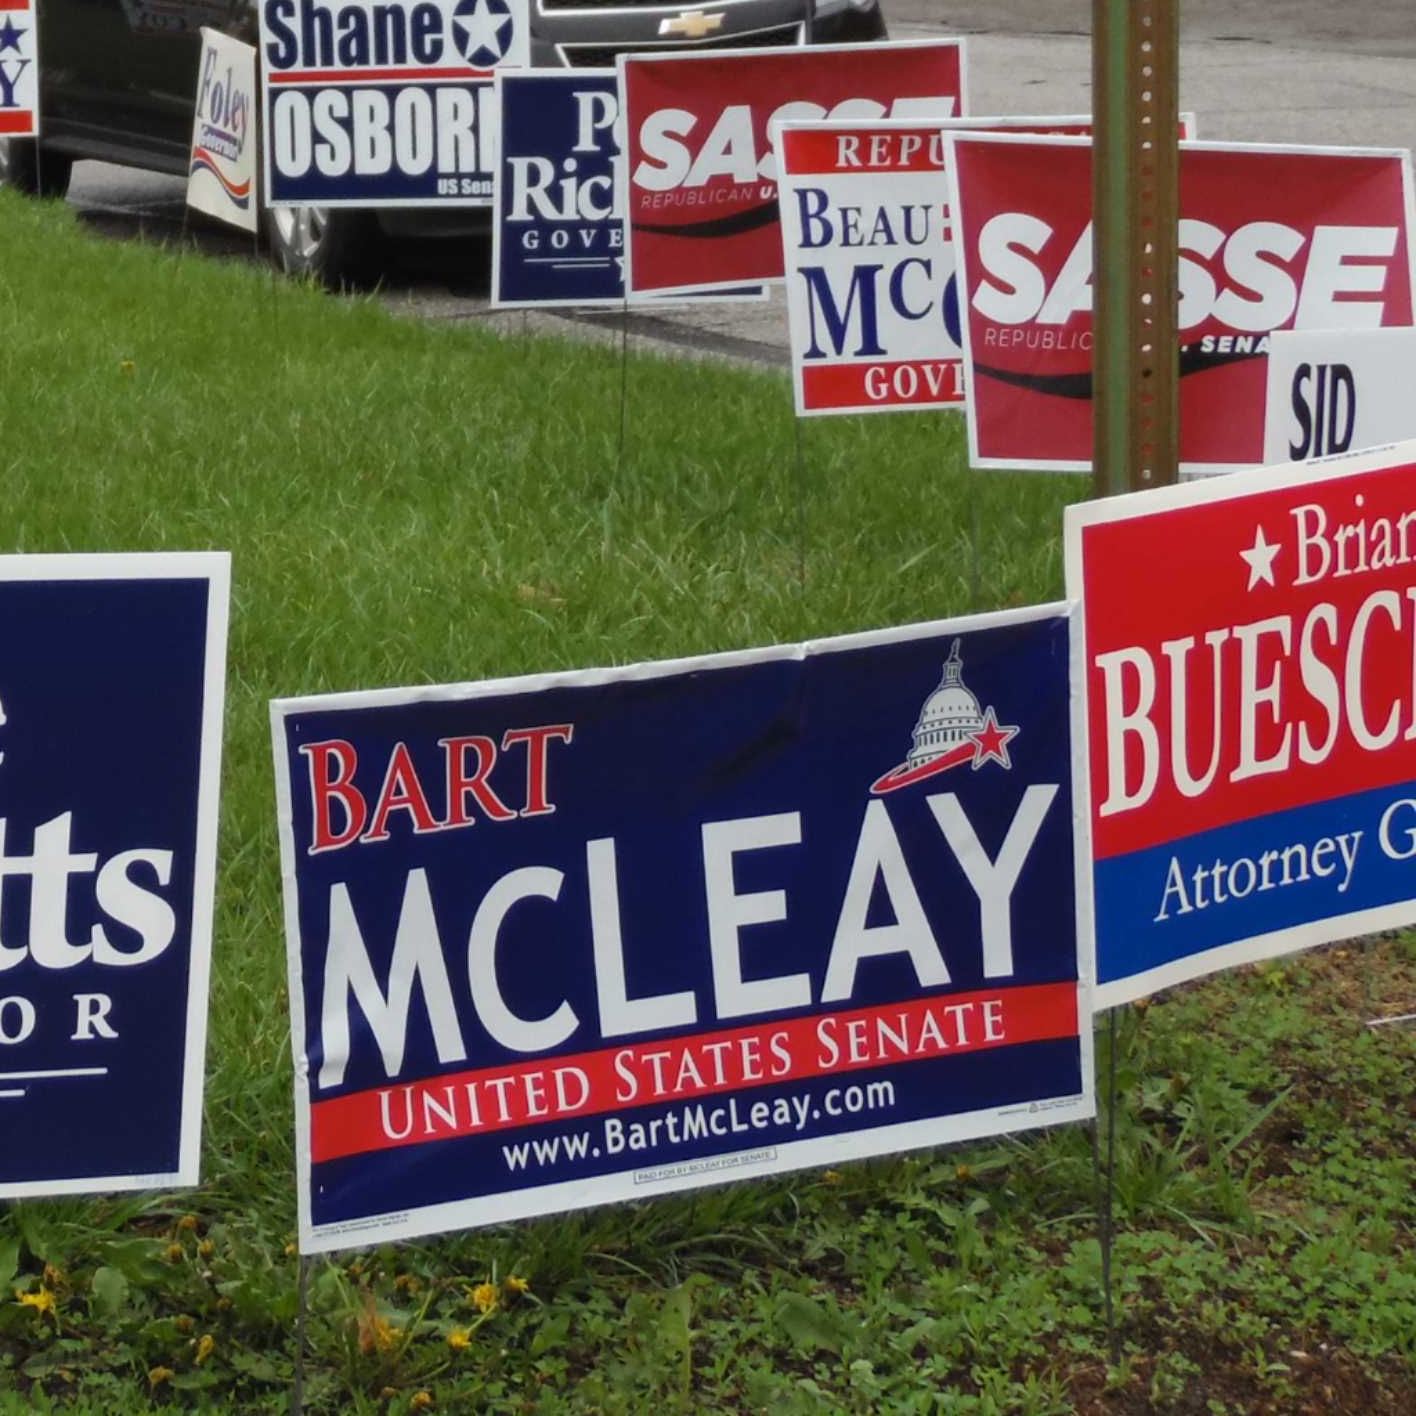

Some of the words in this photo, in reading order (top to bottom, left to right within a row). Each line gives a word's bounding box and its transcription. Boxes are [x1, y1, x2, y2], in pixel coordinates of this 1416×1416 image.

[437, 179, 458, 195] US
[461, 179, 494, 195] Sen
[641, 187, 753, 209] REPUBLICAN
[1288, 362, 1357, 463] SID
[298, 723, 575, 856] BART
[1153, 830, 1364, 923] Attorney
[380, 1065, 591, 1140] UNITED
[615, 1030, 793, 1103] STATES
[817, 999, 1007, 1069] SENATE
[502, 1079, 896, 1172] www.BartMcLeay.com
